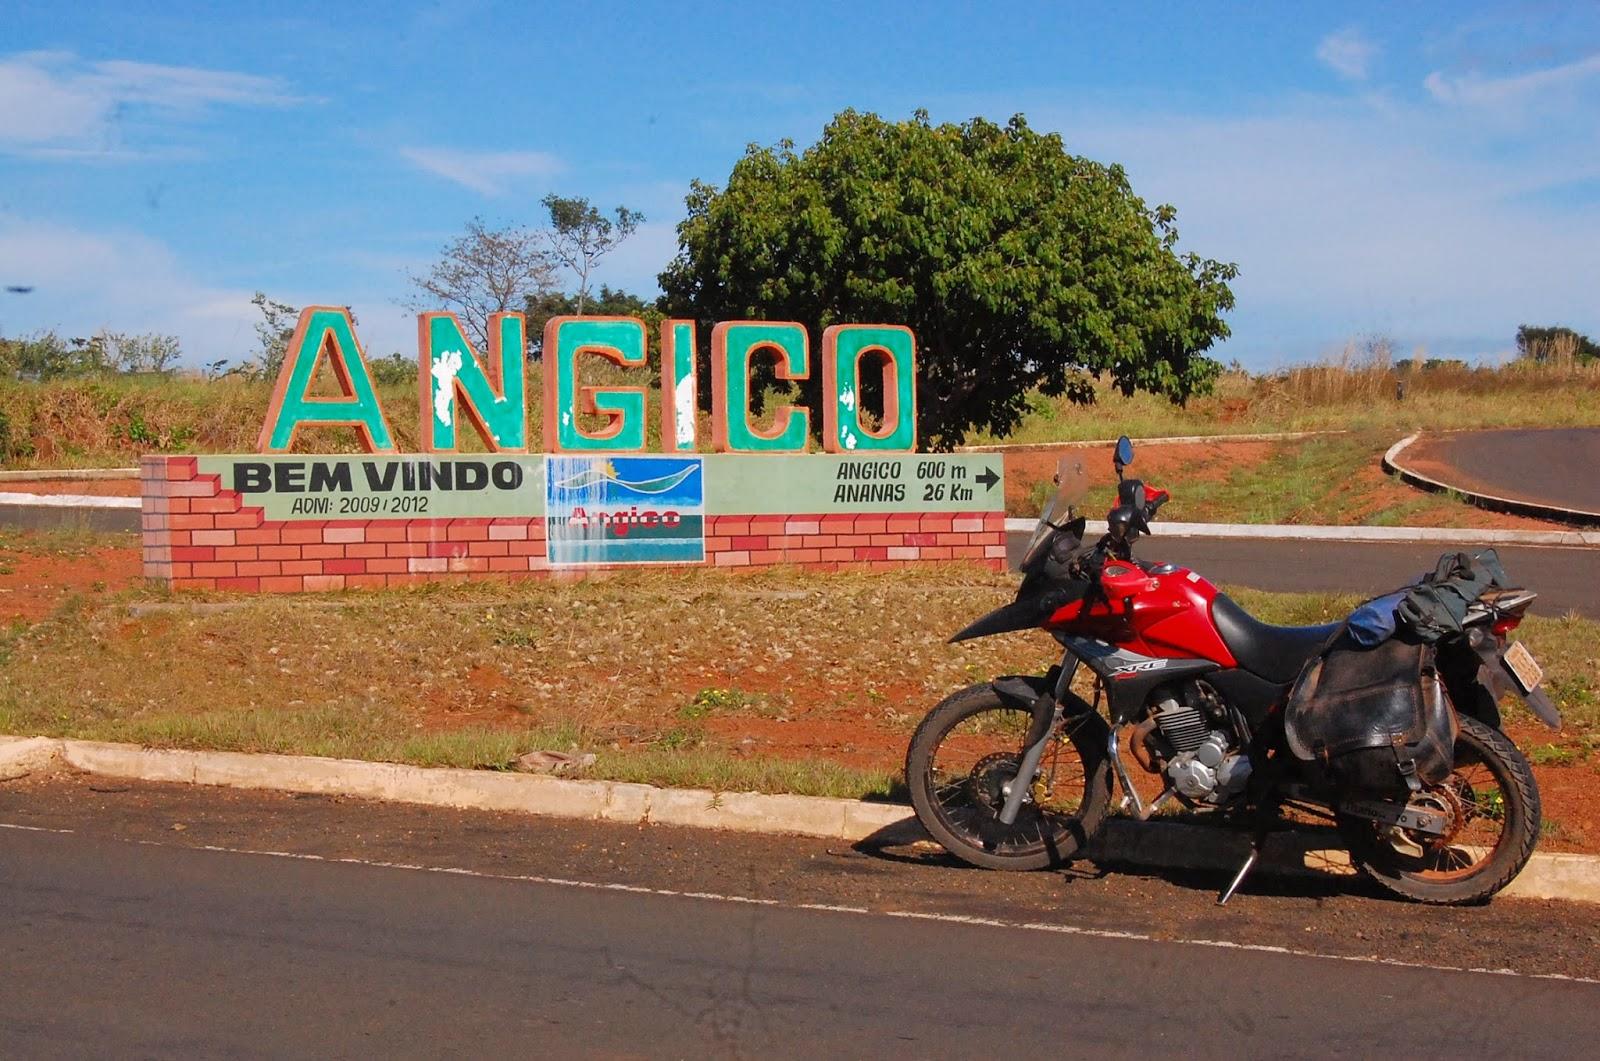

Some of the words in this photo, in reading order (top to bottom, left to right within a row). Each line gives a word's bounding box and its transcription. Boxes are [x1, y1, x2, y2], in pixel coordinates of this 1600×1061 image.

[259, 305, 918, 453] ANGICO
[233, 462, 353, 493] BEM
[362, 461, 524, 492] VINDO
[837, 461, 902, 480] ANGICO
[916, 461, 946, 480] 600
[951, 465, 967, 480] m
[291, 497, 333, 514] ADM:
[833, 483, 906, 503] ANANAS
[923, 483, 946, 502] 26
[950, 483, 973, 502] Km
[569, 506, 681, 537] Angico
